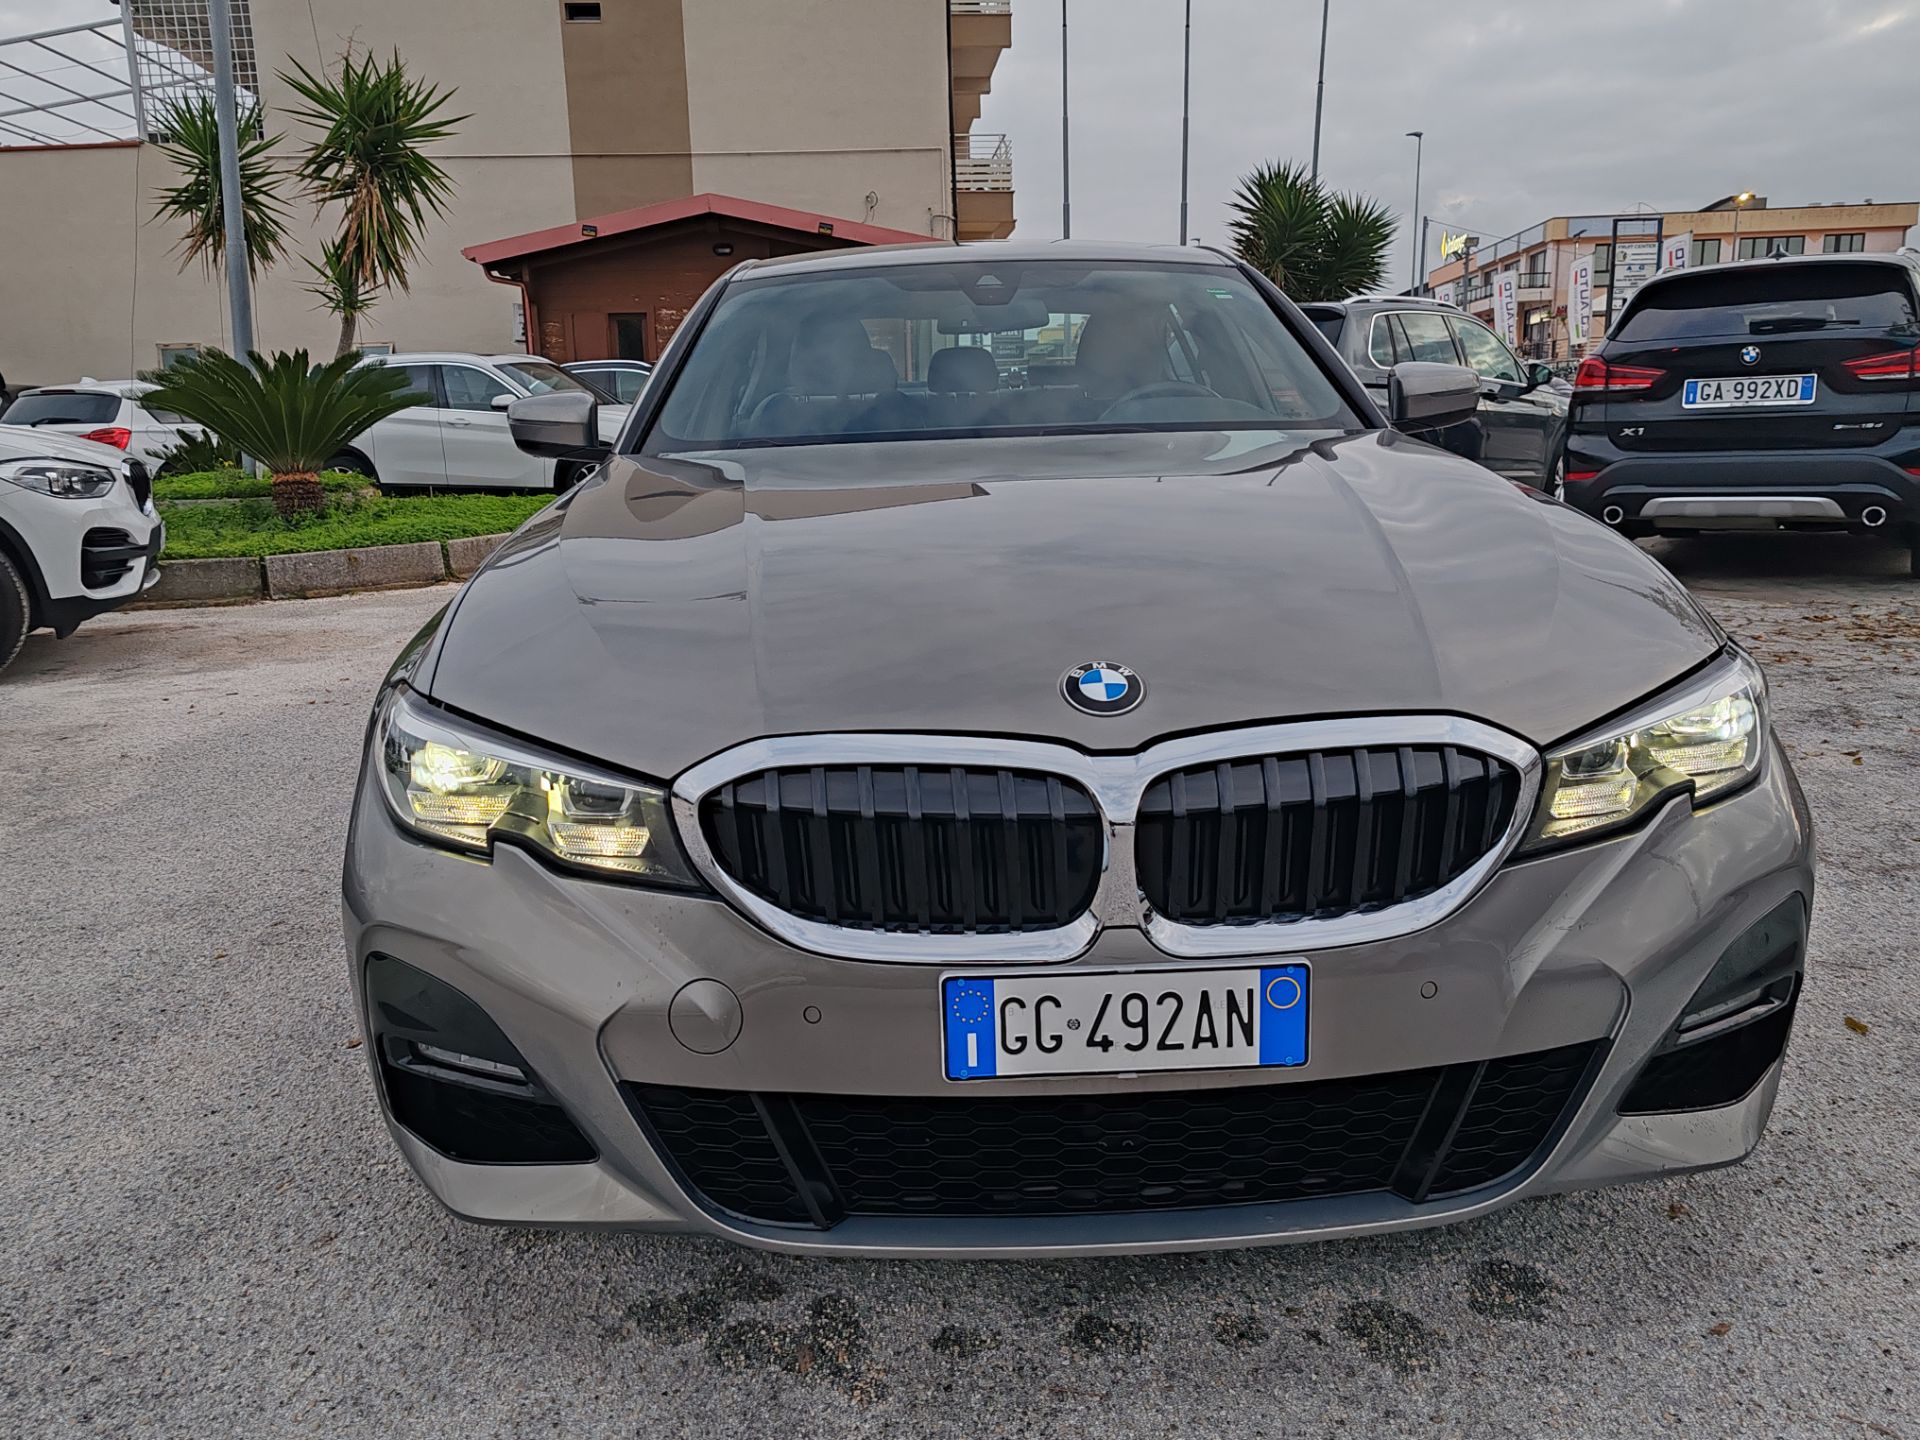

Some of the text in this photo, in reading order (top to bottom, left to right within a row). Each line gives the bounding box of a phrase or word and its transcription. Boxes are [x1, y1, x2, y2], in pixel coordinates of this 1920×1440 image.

[1700, 379, 1799, 401] GA 992XD
[1619, 427, 1645, 437] X1
[1070, 661, 1134, 678] BMW
[1000, 988, 1255, 1055] GG 492AN
